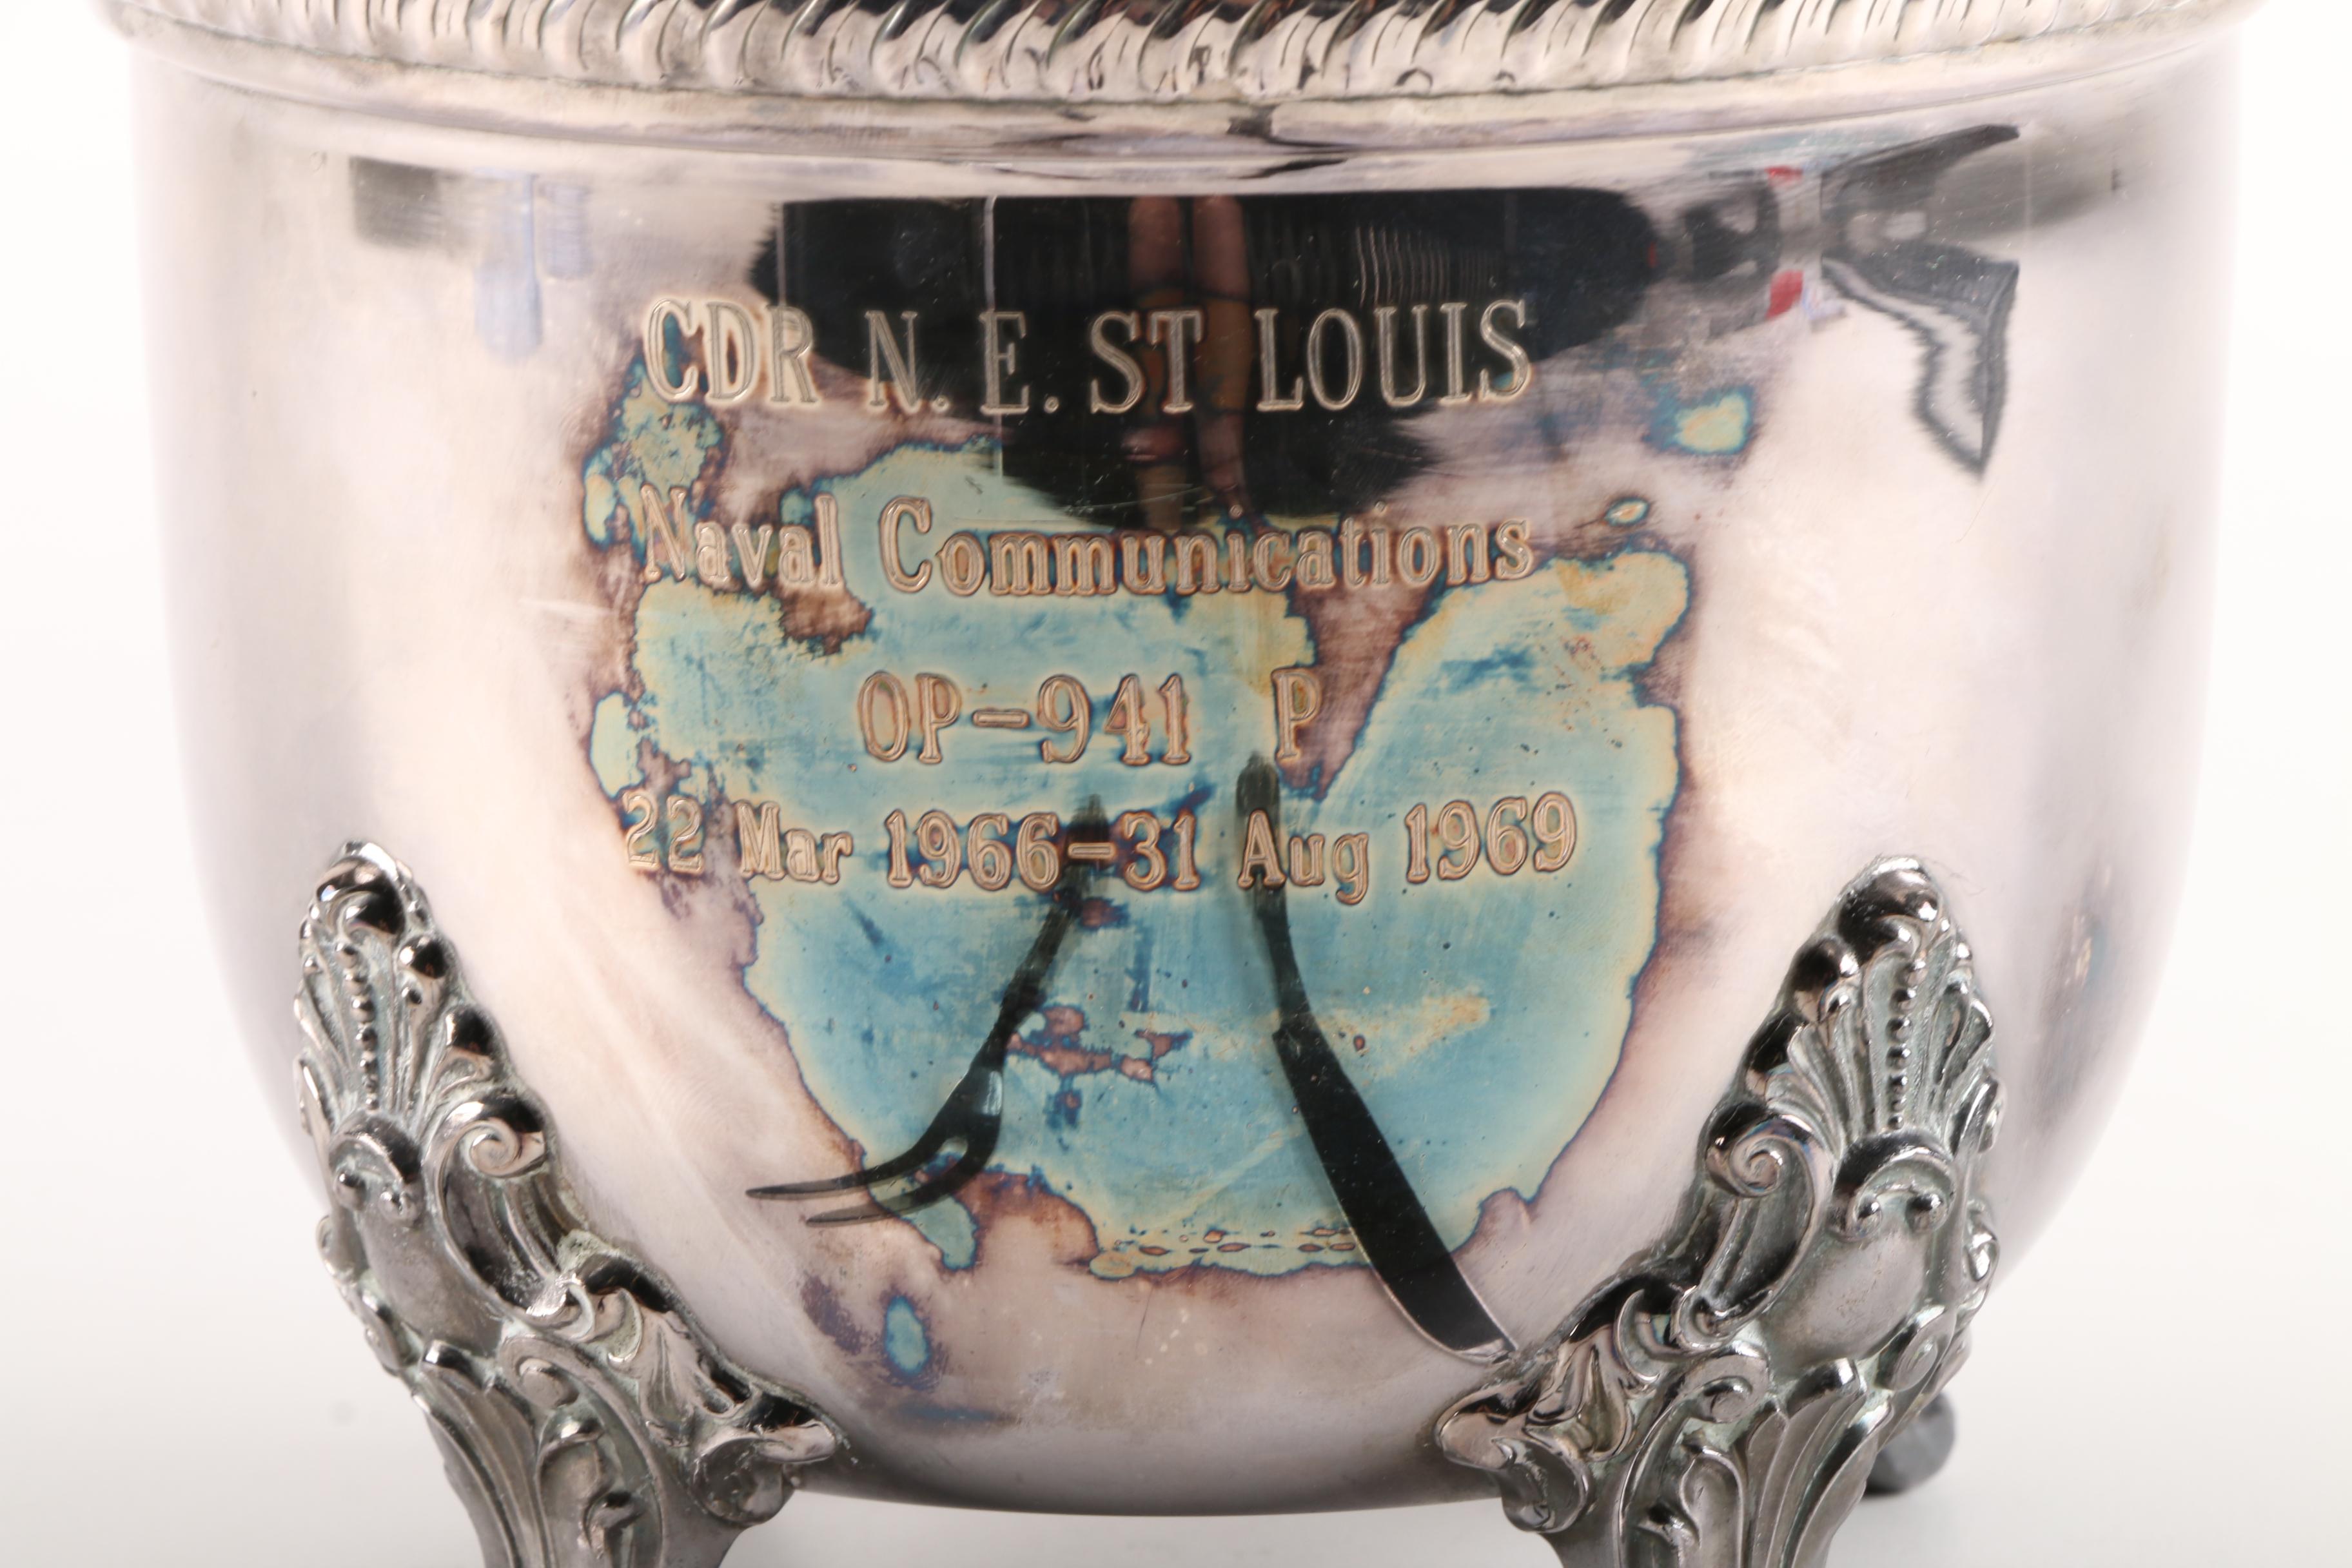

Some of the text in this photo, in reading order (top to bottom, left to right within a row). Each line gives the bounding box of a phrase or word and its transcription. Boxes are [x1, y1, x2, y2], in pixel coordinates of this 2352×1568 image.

[643, 297, 1533, 416] CDR N. E. ST LOUIS
[640, 483, 1536, 596] Naval Communications
[1271, 666, 1322, 766] P
[622, 790, 704, 876] 22
[734, 799, 854, 884] Mar
[1237, 808, 1370, 905] Aug
[1404, 791, 1577, 884] 1969
